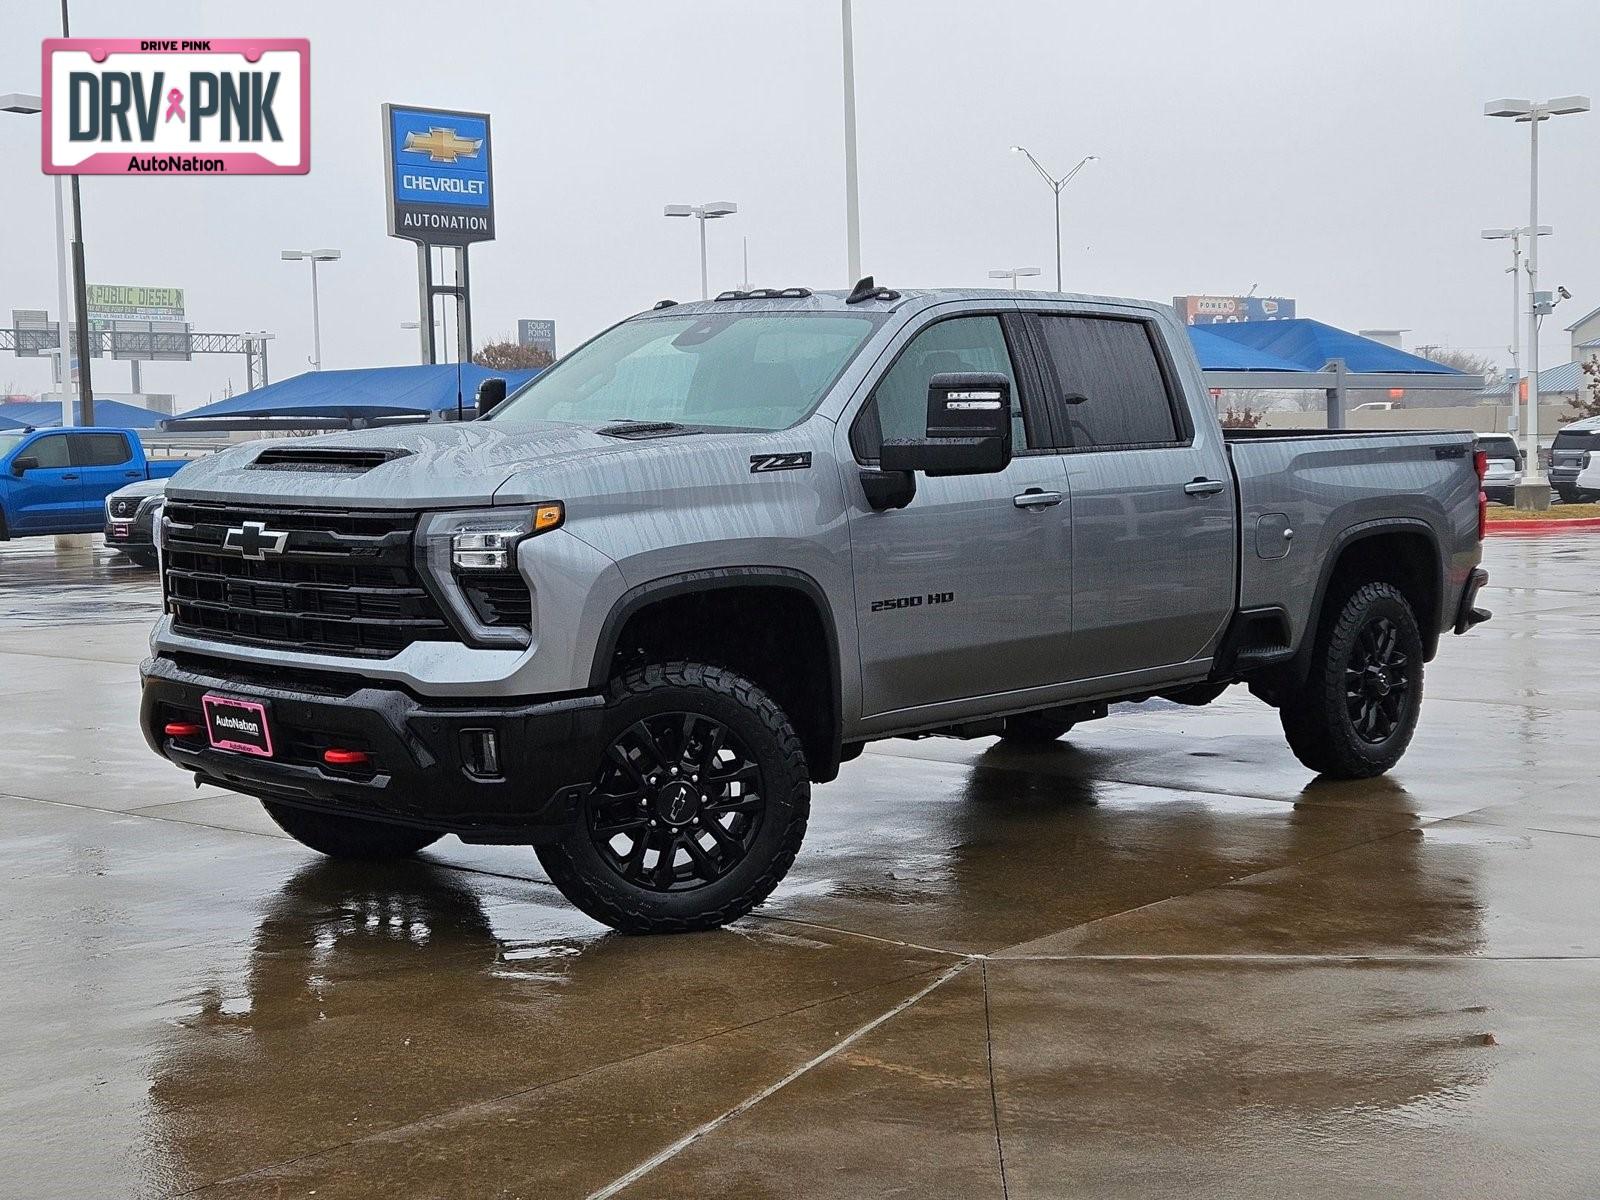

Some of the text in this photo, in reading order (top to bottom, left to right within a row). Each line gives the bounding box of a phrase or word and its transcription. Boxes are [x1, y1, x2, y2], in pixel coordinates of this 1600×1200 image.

[403, 175, 485, 194] CHEVROLET
[404, 213, 487, 230] AUTONATION
[96, 286, 174, 307] PUBLIC DIESEL
[527, 321, 545, 330] FOUR
[527, 329, 551, 337] POINTS
[871, 591, 954, 612] 2500 HD
[216, 715, 259, 732] AutoNation
